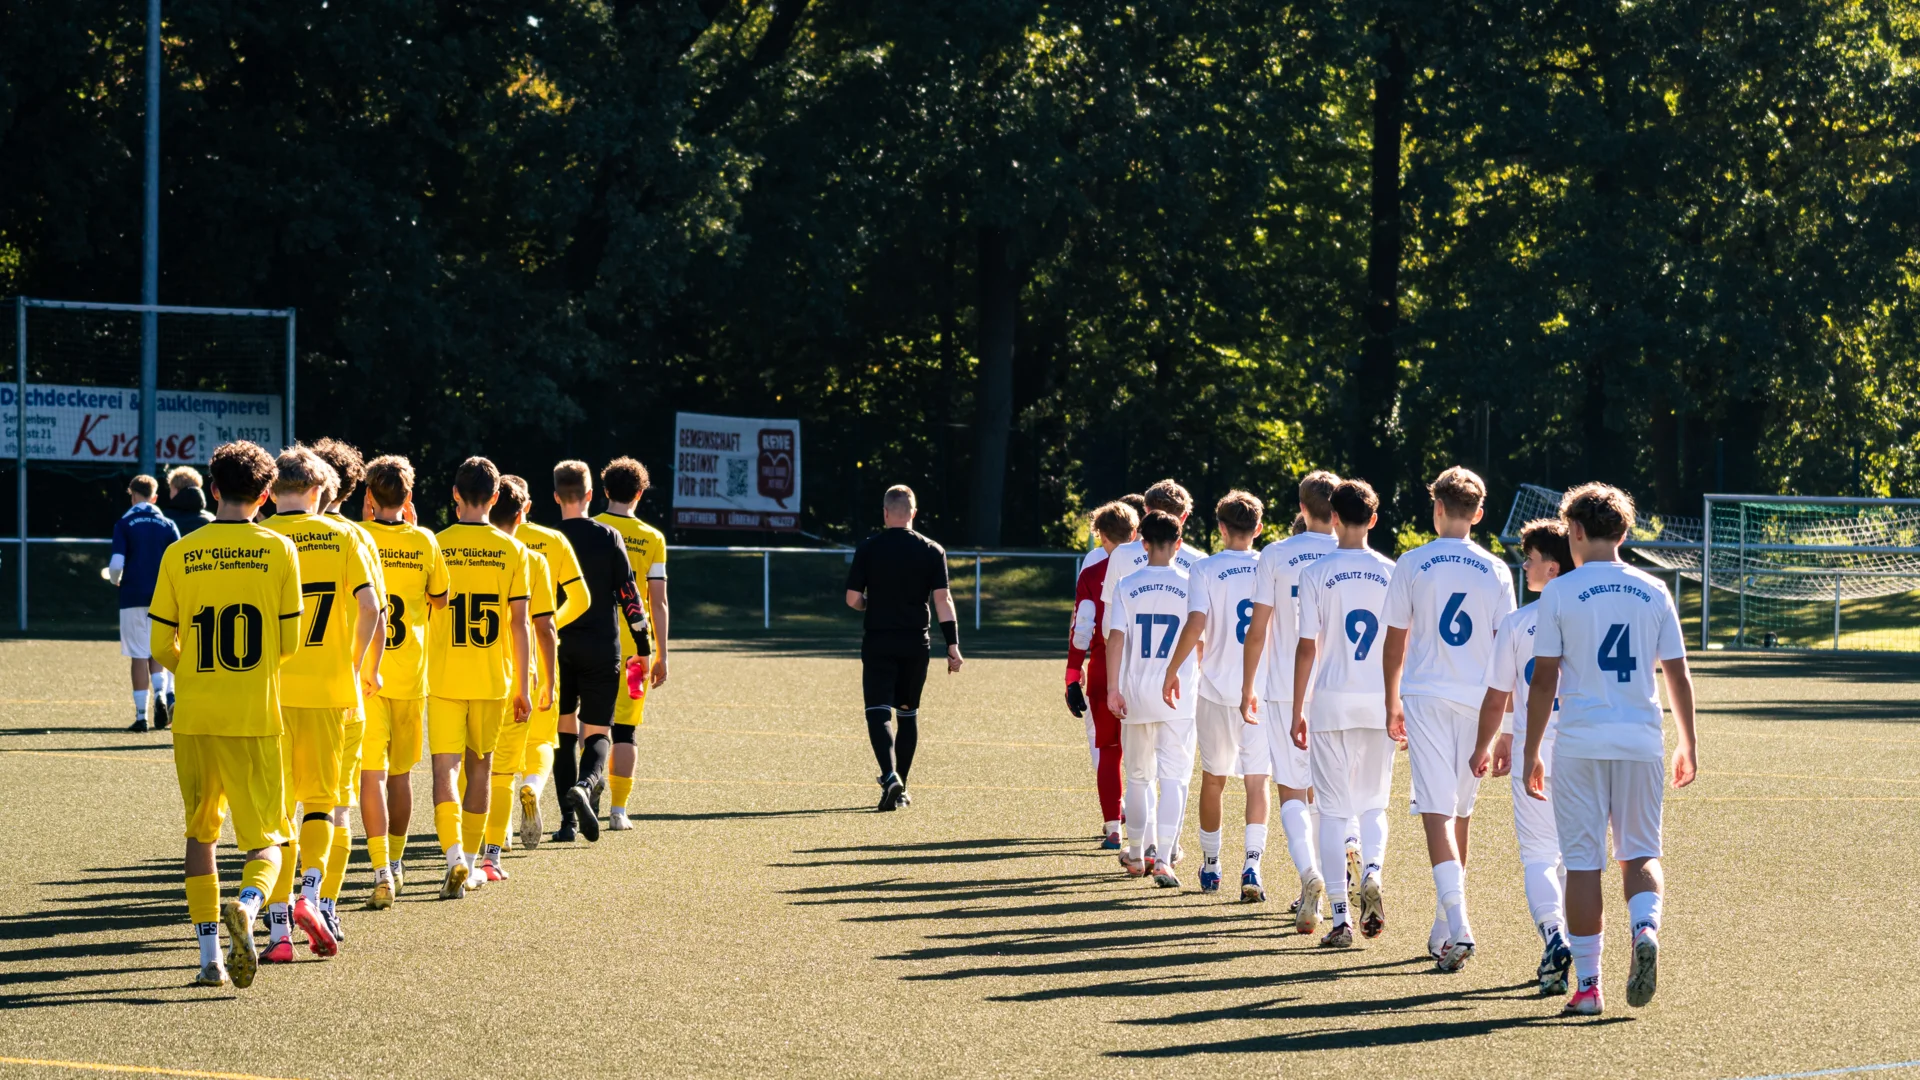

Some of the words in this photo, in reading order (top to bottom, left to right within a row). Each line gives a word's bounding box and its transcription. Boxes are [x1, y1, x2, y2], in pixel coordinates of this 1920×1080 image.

[157, 395, 270, 419] auklempnerei
[3, 412, 57, 428] Senenberg
[680, 429, 741, 452] GEMEINSCHAFT
[679, 452, 719, 474] BEGINNT
[678, 477, 696, 497] VOR
[296, 542, 340, 552] enftenberg
[184, 549, 203, 564] FSV
[445, 559, 464, 567] rieske
[468, 559, 506, 570] Senftenberg
[1133, 556, 1143, 566] SG
[1289, 557, 1299, 567] SG
[1298, 553, 1326, 562] BEELIT
[1420, 561, 1432, 572] SG
[1430, 555, 1461, 565] BEELITZ
[1462, 557, 1489, 574] 1912/90
[185, 562, 213, 575] Brieske
[219, 560, 269, 573] Senftenberg
[384, 560, 424, 571] Senftenberg
[1217, 570, 1228, 581] SG
[1226, 566, 1252, 576] BEELITZ
[1325, 578, 1336, 589] SG
[1334, 571, 1362, 582] BEELITZ
[1363, 572, 1388, 587] 1912/90
[1129, 589, 1139, 599] SG
[1138, 584, 1164, 594] BEELITZ
[1165, 585, 1187, 599] 1912/90
[1578, 590, 1591, 602] SG
[1589, 584, 1621, 595] BEELITZ
[1623, 585, 1651, 603] 1912/90
[449, 591, 500, 648] 15
[1235, 598, 1255, 645] 8
[1438, 592, 1473, 647] 6
[190, 603, 263, 673] 10
[1135, 613, 1181, 659] 17
[1345, 608, 1379, 661] 9
[1597, 623, 1637, 683] 4
[487, 844, 499, 855] FS
[1334, 902, 1347, 914] FS
[273, 911, 287, 924] FS
[200, 922, 217, 935] FS
